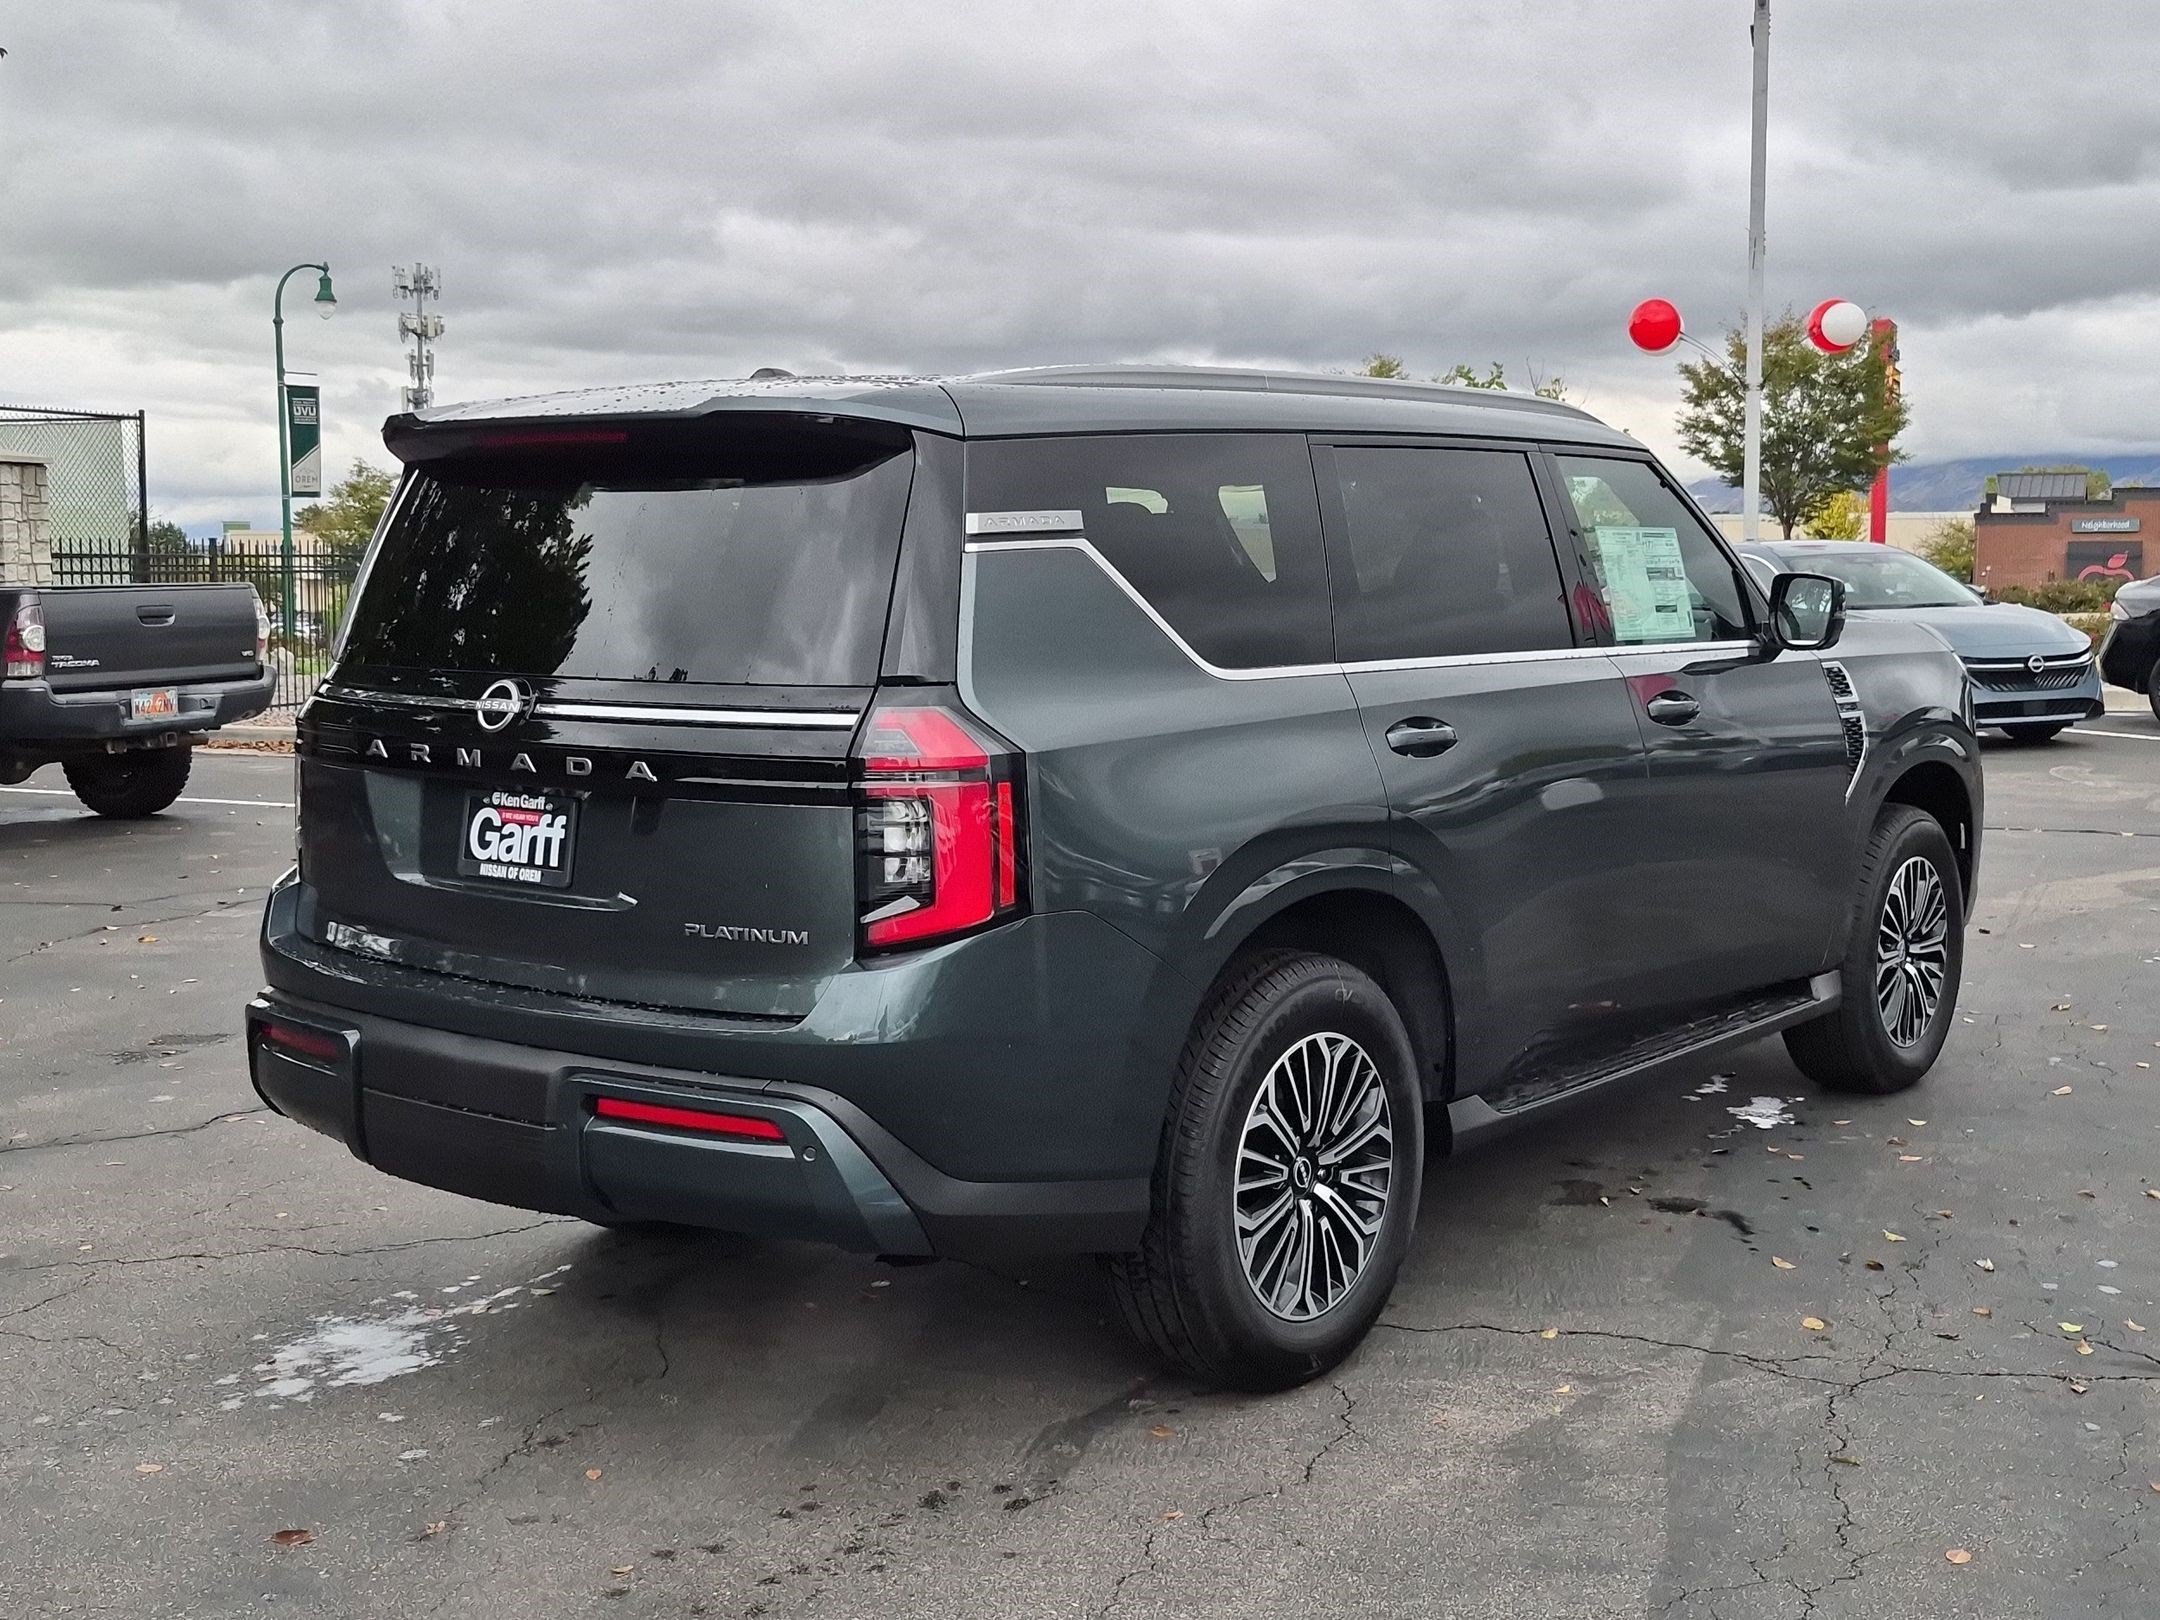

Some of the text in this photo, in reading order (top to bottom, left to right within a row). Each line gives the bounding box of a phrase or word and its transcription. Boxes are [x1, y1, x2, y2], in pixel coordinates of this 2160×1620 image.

[293, 406, 317, 416] UVU
[295, 475, 318, 484] OREM
[984, 515, 1065, 527] ARMADA
[51, 659, 100, 668] TACOMA
[475, 700, 520, 713] NISSAN
[365, 739, 658, 782] ARMADA
[501, 792, 546, 810] Ken Garff
[470, 807, 567, 867] Garff
[480, 863, 542, 883] NISSAN OF OREM
[685, 923, 808, 945] PLATINUM
